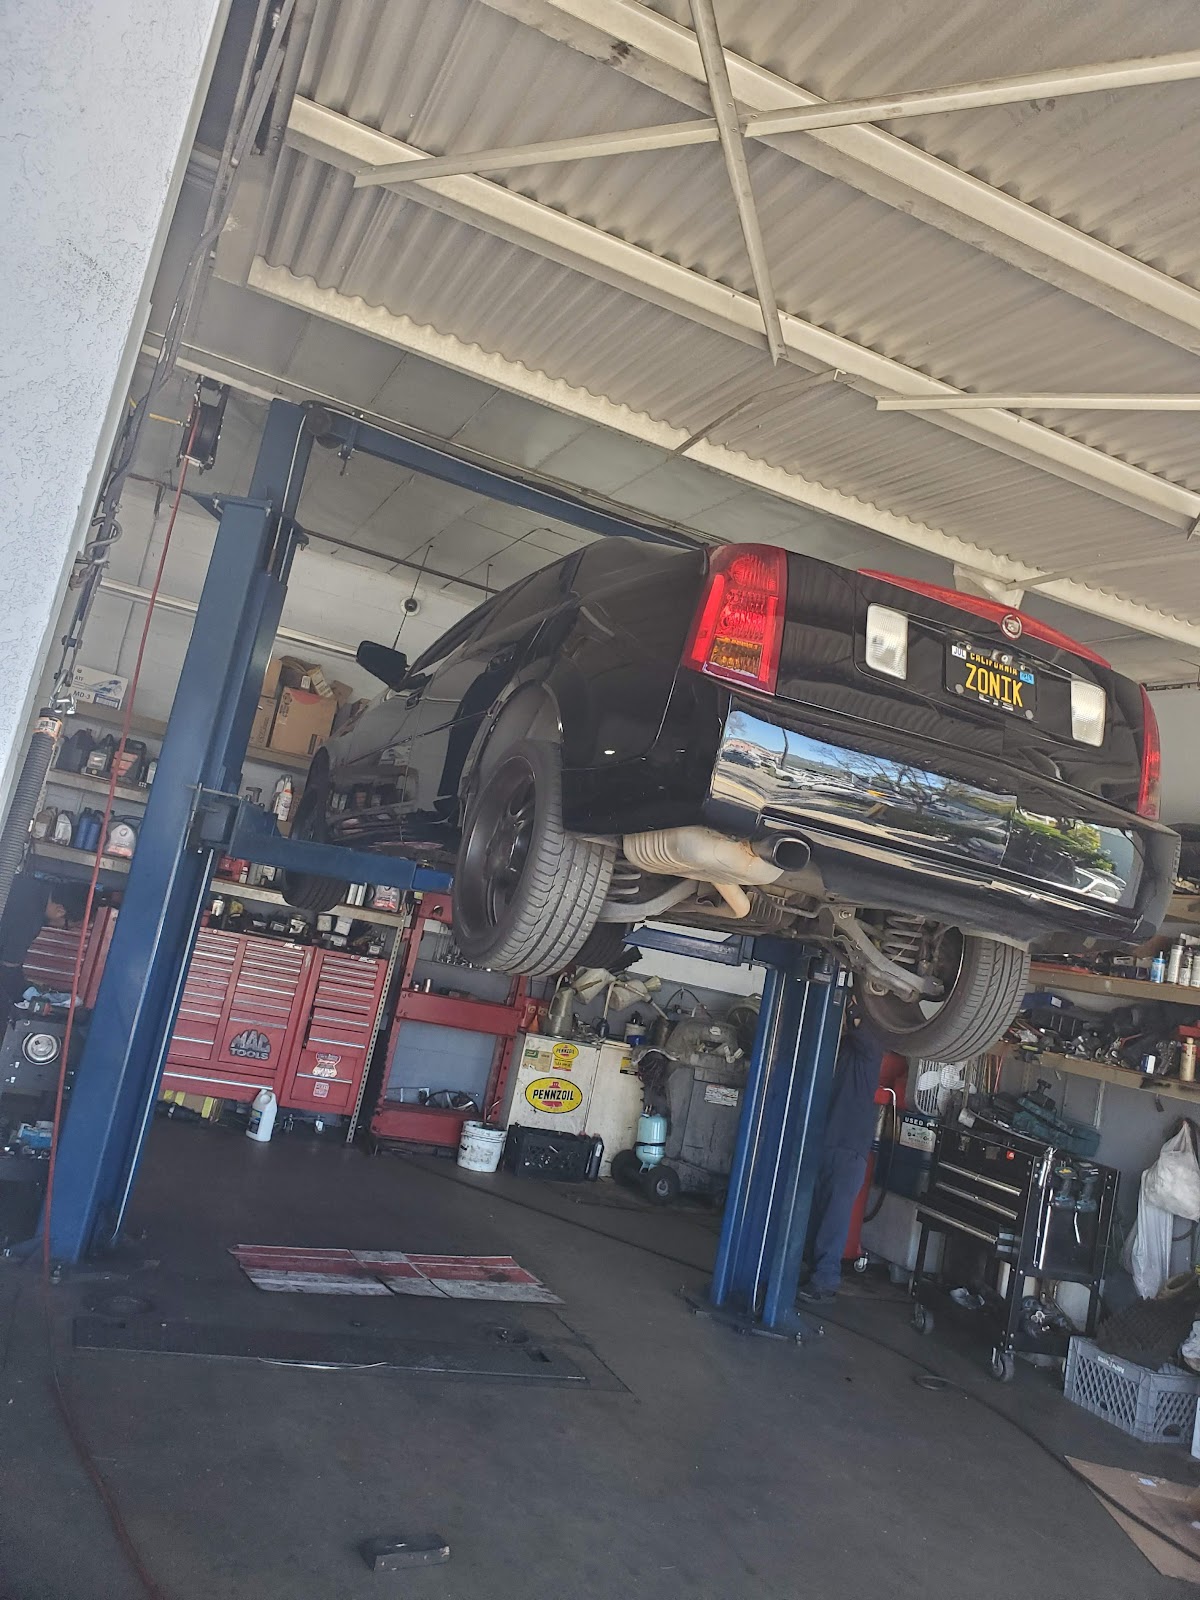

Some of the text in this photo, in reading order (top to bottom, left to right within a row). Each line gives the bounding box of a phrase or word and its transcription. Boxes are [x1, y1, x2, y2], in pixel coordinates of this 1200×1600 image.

[953, 647, 965, 657] JUL
[970, 652, 1018, 676] CALIFORNIA
[965, 662, 1023, 708] ZONIK
[229, 1029, 271, 1053] MAC
[230, 1048, 269, 1060] TOOLS
[532, 1089, 574, 1101] PENNZOIL
[904, 1116, 924, 1126] USED
